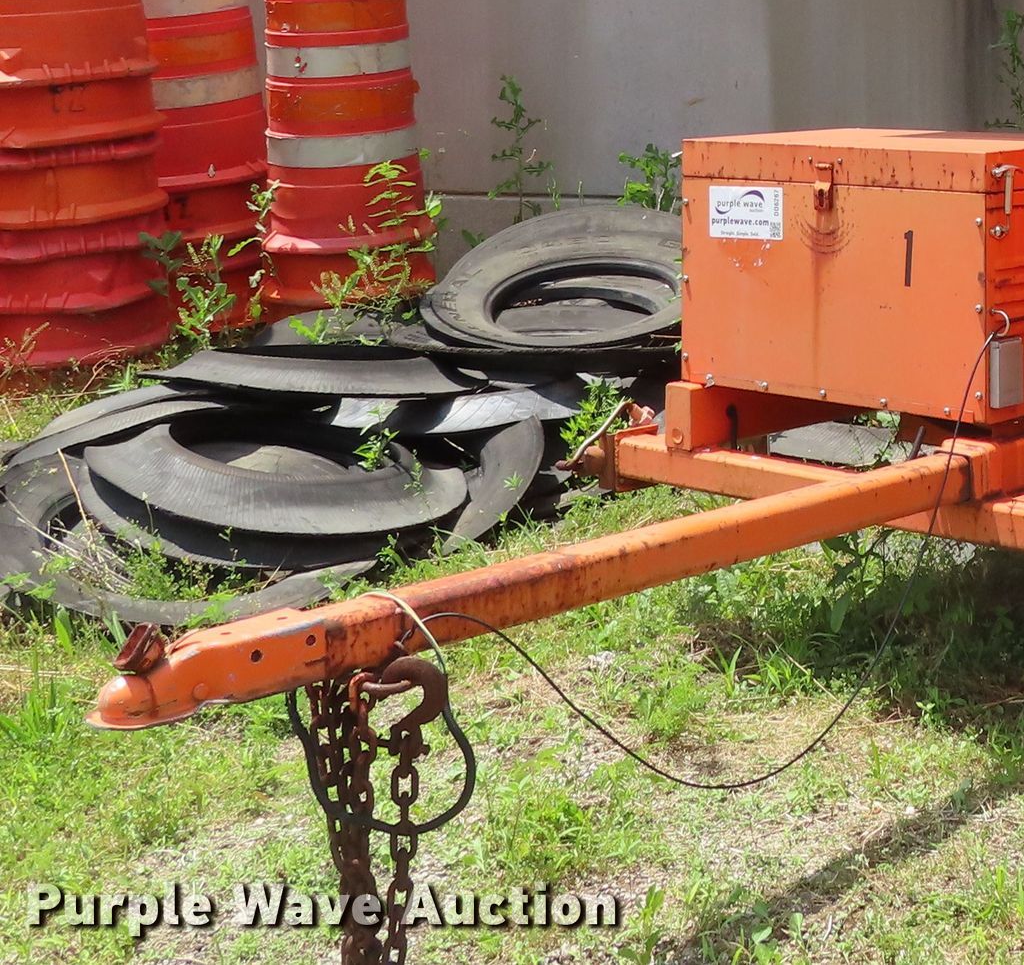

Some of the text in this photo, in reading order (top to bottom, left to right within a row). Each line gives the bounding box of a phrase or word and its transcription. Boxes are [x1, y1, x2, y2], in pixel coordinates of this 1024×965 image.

[716, 199, 741, 208] purple
[711, 216, 770, 227] purplewave.com
[903, 229, 914, 288] 1
